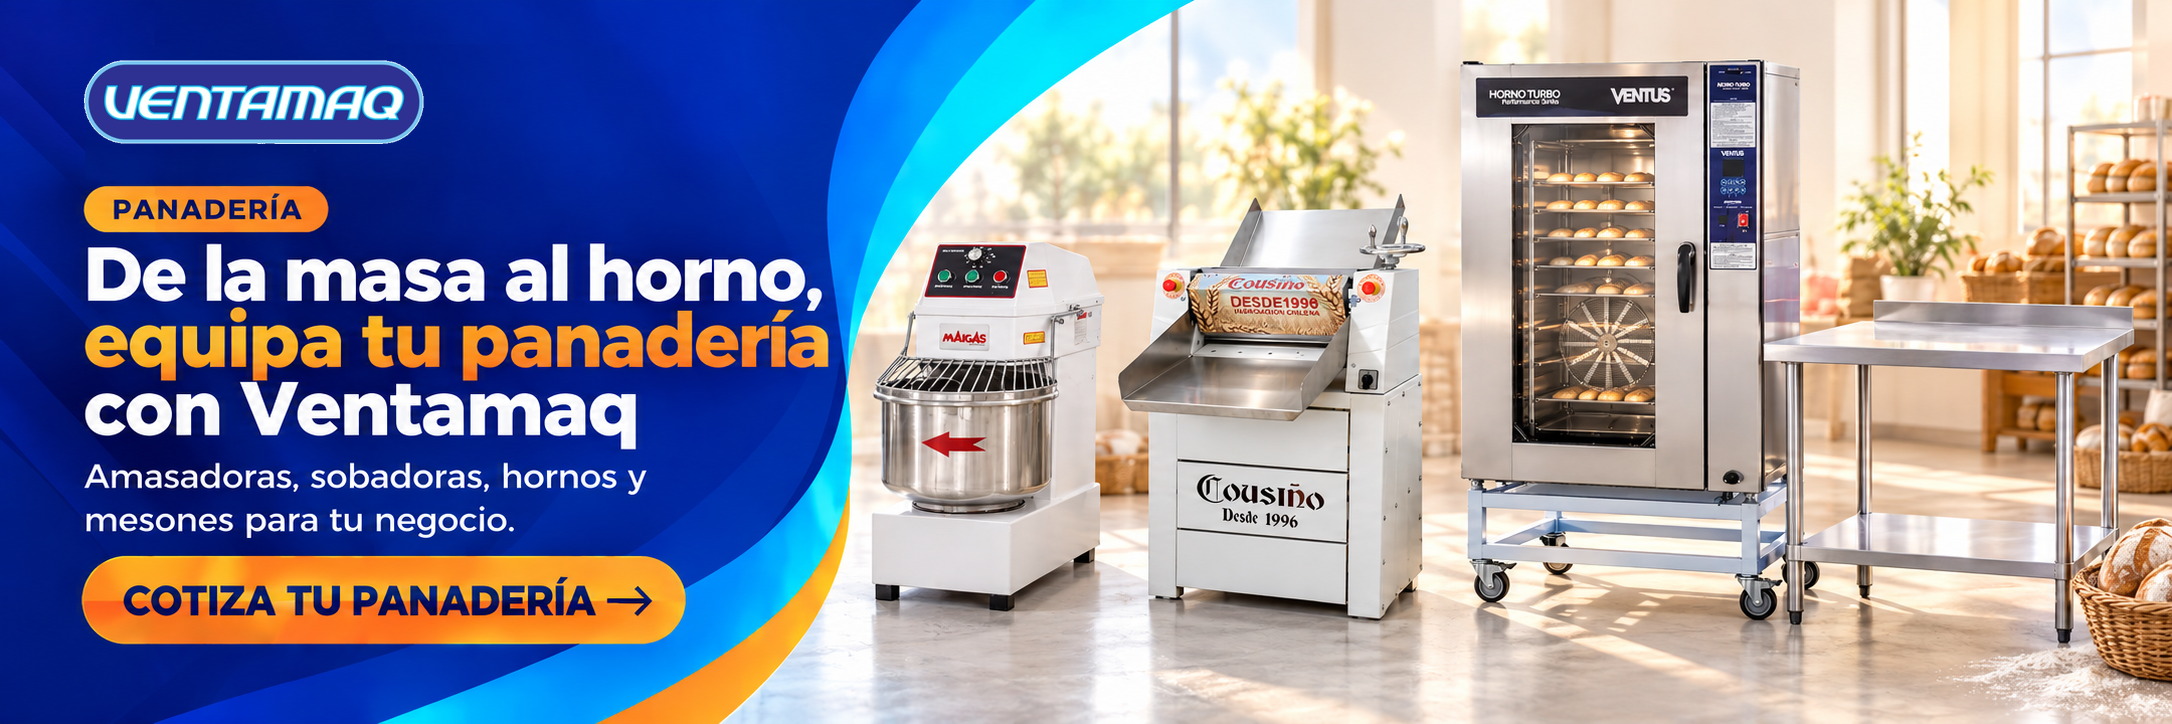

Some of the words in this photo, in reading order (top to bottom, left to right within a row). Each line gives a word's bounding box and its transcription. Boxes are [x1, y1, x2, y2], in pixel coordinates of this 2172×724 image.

[1489, 89, 1526, 99] HORNO
[1527, 89, 1561, 99] TURBO
[1610, 87, 1671, 105] VENTUS
[1222, 507, 1259, 524] Desde
[1265, 512, 1299, 529] 1996
